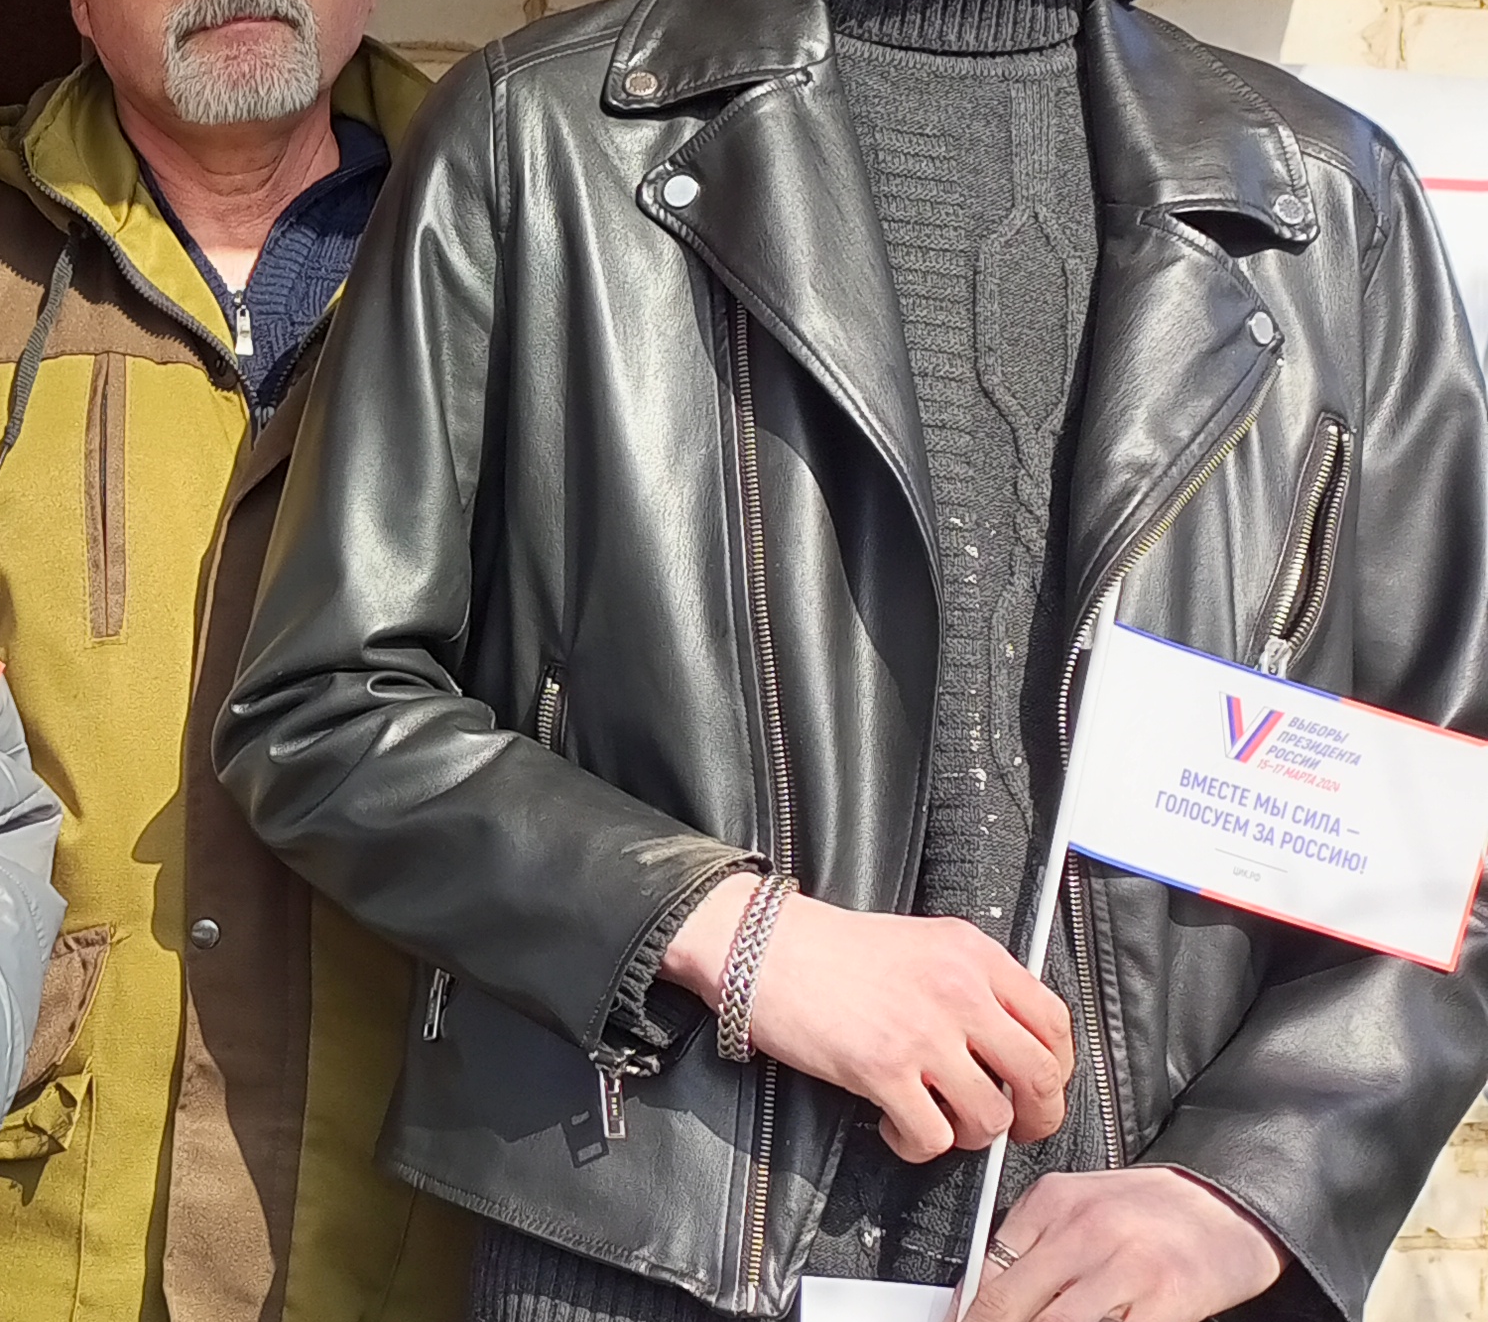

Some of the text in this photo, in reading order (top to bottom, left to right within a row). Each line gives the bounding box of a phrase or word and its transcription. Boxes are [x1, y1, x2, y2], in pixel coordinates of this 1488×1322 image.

[1288, 716, 1350, 744] ВЫБОРЫ
[1265, 745, 1321, 770] РОССИИ
[1276, 731, 1362, 766] ПРЕЗИДЕНТА
[1282, 767, 1316, 785] МАРТА
[1315, 777, 1341, 793] 2024
[1179, 768, 1251, 807] ВМЕСТЕ
[1253, 792, 1288, 819] МЫ
[1291, 805, 1341, 837] СИЛА
[1155, 790, 1368, 874] ГОЛОСУЕМ ЗА РОССИЮ!
